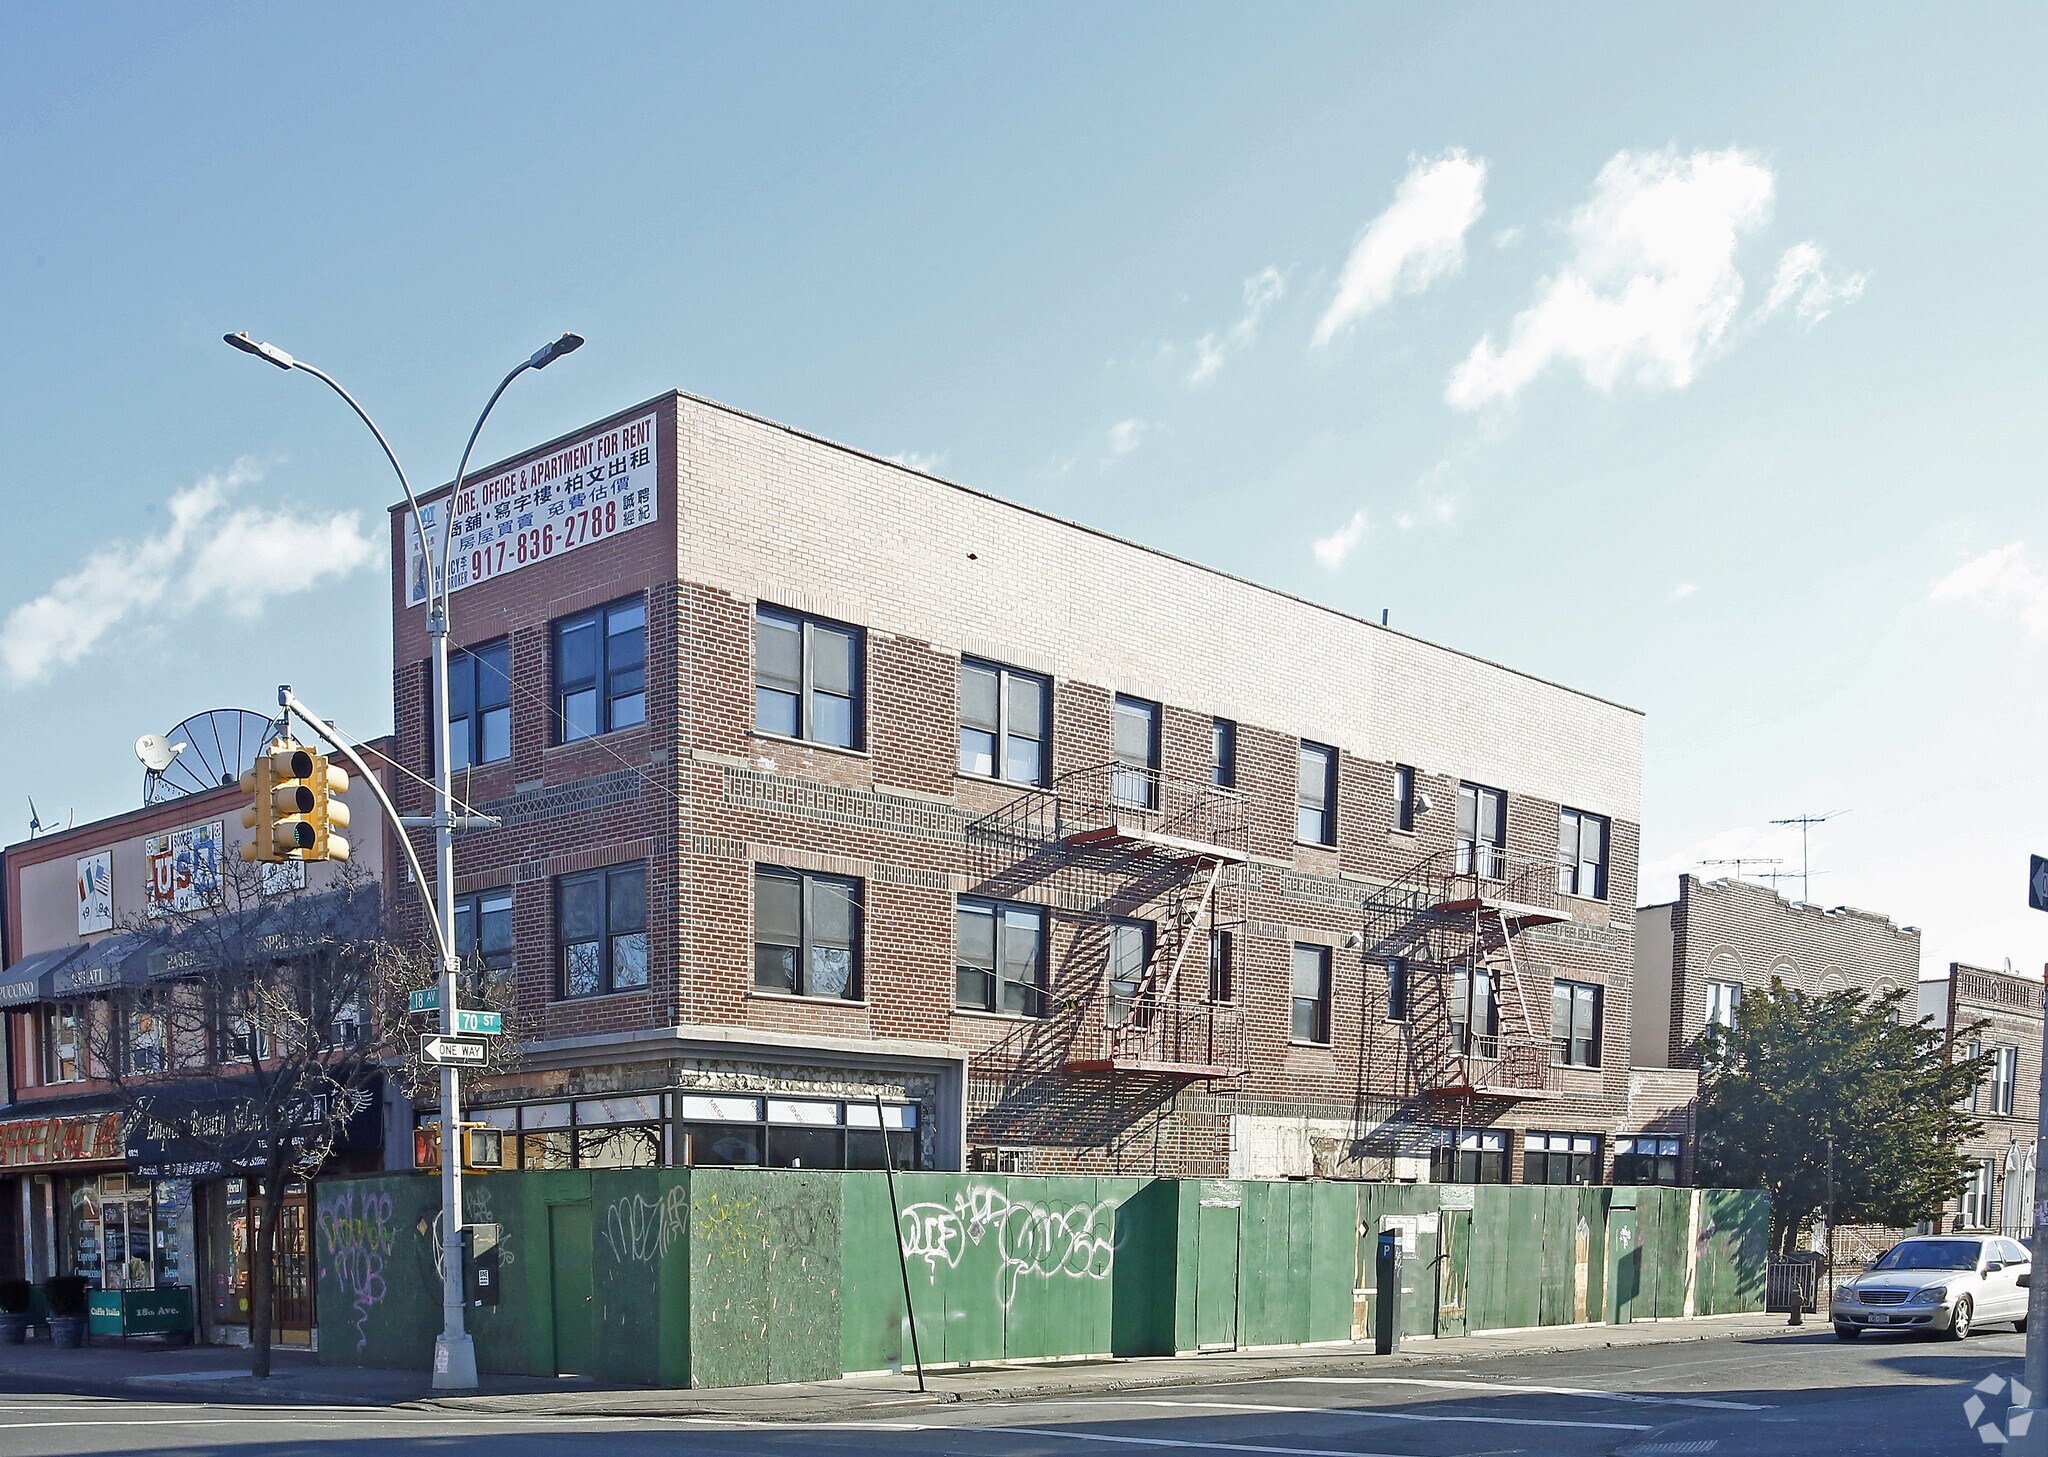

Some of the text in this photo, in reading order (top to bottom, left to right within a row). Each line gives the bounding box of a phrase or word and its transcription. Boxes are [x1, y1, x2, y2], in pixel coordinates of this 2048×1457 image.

[446, 489, 479, 519] SORE,
[482, 473, 517, 506] OFFICE
[520, 470, 527, 491] &
[531, 442, 594, 487] APARTMENT
[597, 432, 618, 461] FOR
[623, 419, 652, 451] RENT
[472, 500, 617, 580] 917-836-2788
[435, 559, 460, 580] NCY
[82, 907, 90, 920] 19
[414, 990, 437, 1009] 18 AV
[463, 1013, 495, 1031] 70 ST
[439, 1044, 481, 1057] ONE WAY
[1383, 1245, 1390, 1256] P
[105, 1307, 120, 1317] Italia
[157, 1306, 179, 1316] Ave.
